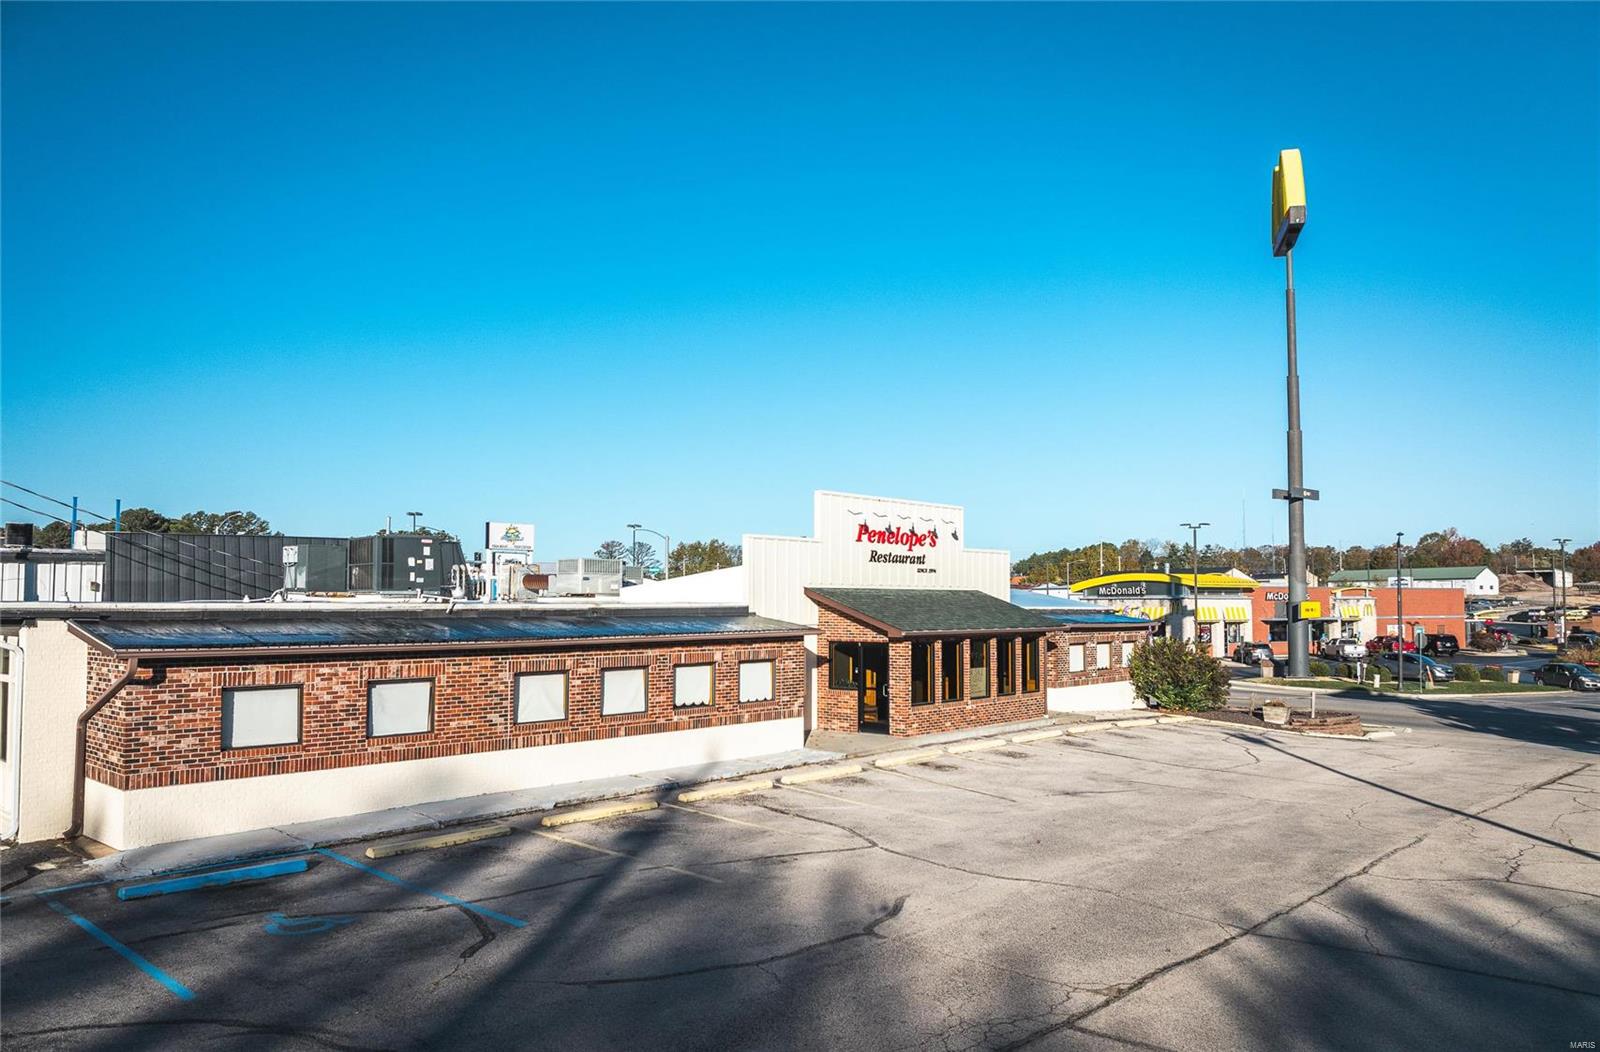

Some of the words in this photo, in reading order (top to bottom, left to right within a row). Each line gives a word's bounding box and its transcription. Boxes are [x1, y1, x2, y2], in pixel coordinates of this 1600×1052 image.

[855, 523, 938, 551] Penelope's
[869, 549, 926, 565] Restaurant
[1098, 586, 1147, 595] McDonald's
